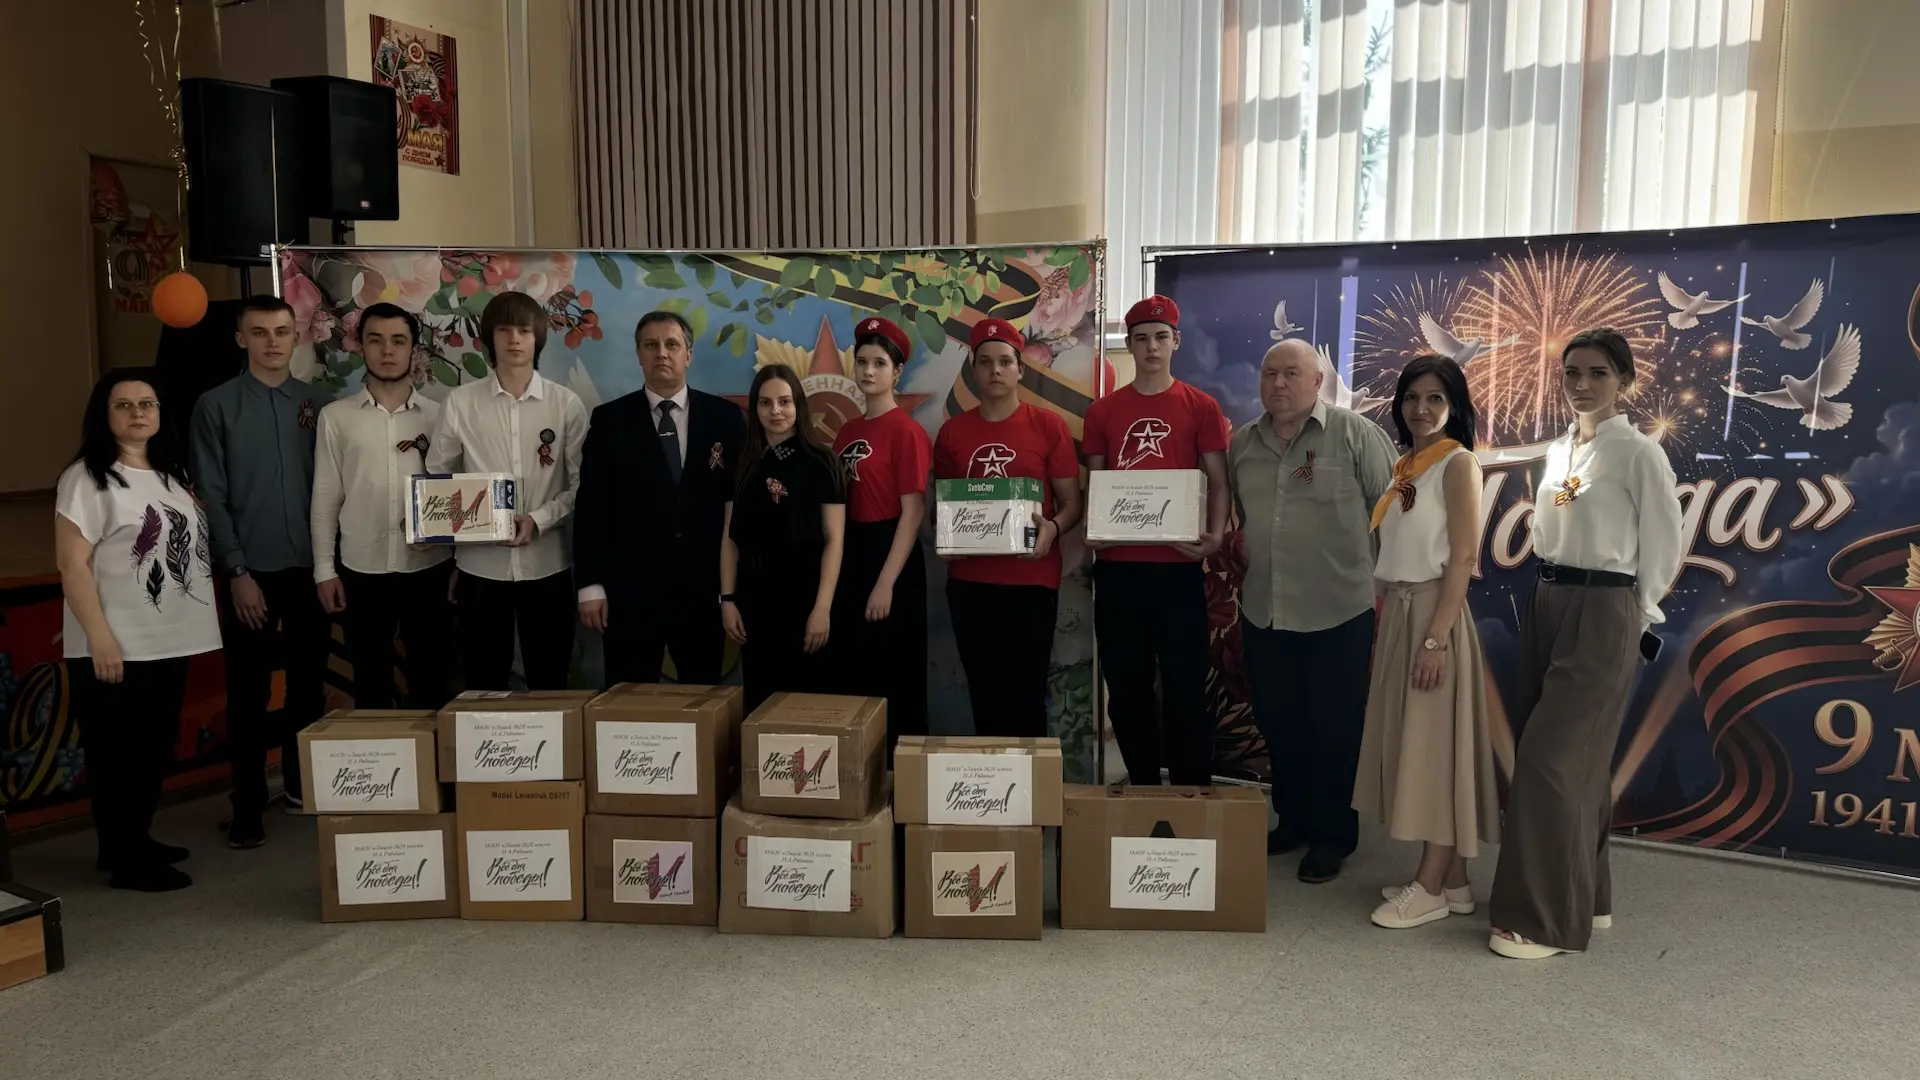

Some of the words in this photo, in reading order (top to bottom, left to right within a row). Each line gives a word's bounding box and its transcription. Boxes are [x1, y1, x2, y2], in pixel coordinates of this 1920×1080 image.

[407, 130, 444, 152] МАЯ
[967, 483, 995, 493] SvetoCopy
[1132, 500, 1146, 512] для
[972, 508, 988, 520] для
[1814, 699, 1874, 776] 9
[500, 741, 517, 754] для
[638, 751, 654, 764] для
[356, 768, 373, 782] для
[492, 790, 512, 799] Model
[515, 790, 547, 799] Levenhuk
[971, 783, 987, 797] для
[381, 861, 398, 874] для
[510, 859, 526, 872] для
[790, 868, 806, 881] для
[1154, 867, 1171, 881] для
